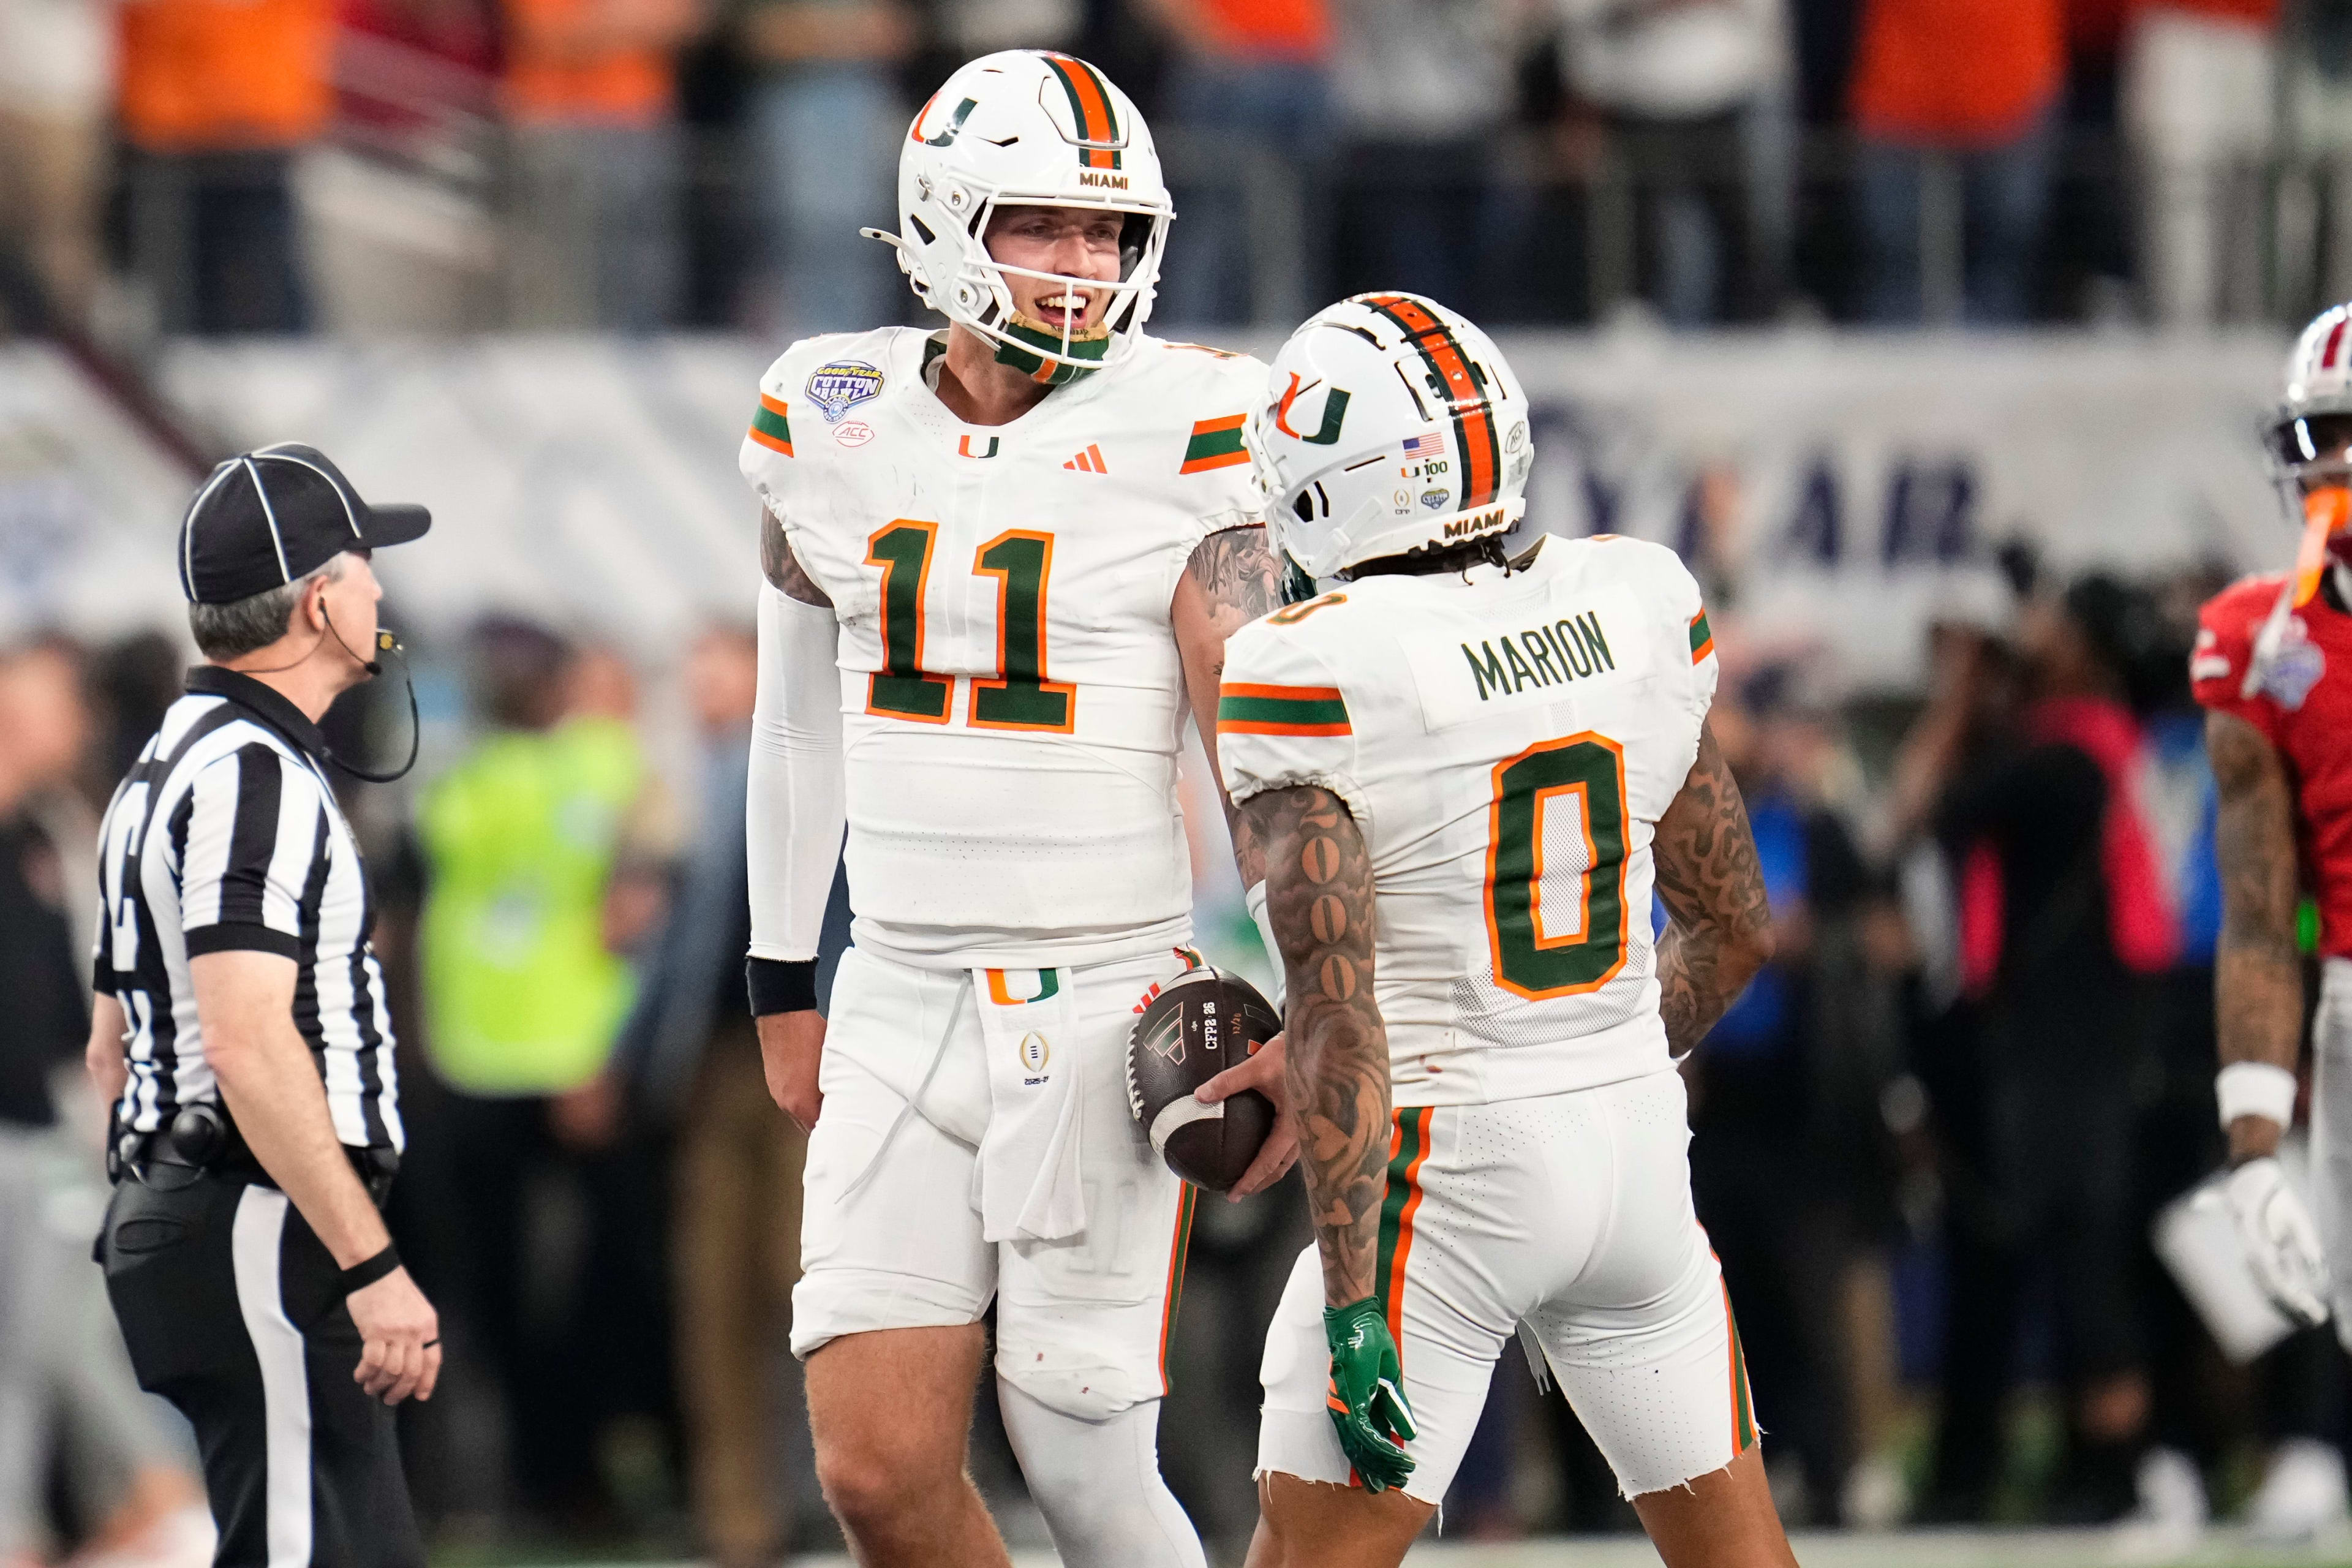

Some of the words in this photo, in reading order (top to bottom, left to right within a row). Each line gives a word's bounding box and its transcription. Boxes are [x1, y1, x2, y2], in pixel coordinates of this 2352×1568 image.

[1080, 173, 1128, 190] MIAMI
[810, 376, 879, 397] COTTON
[820, 388, 861, 400] BOWL
[839, 427, 869, 437] ACC
[1424, 461, 1448, 475] 100
[1444, 508, 1505, 539] MIAMI
[864, 519, 1076, 734] 11
[1461, 611, 1616, 700] MARION
[1483, 730, 1632, 1001] 0
